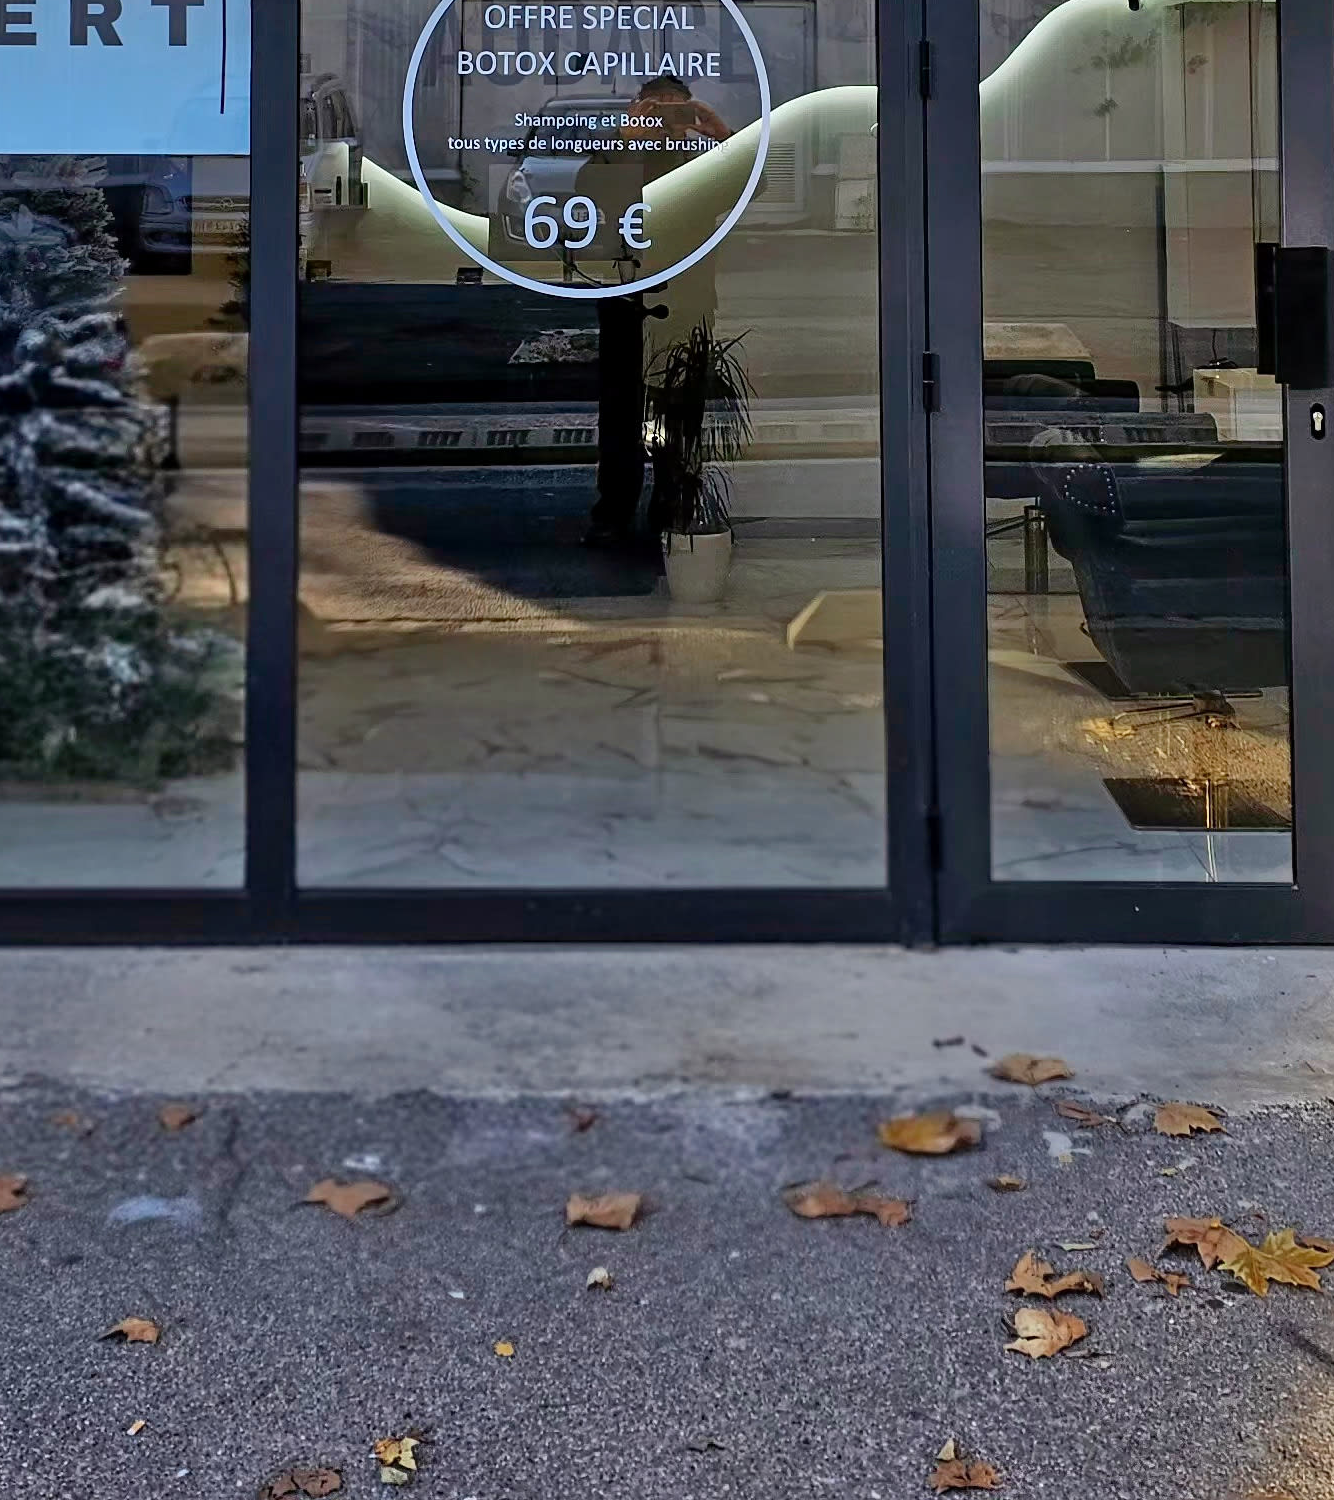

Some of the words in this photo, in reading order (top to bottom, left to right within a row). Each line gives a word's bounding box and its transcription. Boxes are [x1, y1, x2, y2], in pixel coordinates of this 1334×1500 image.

[484, 4, 574, 29] OFFRE
[582, 5, 695, 30] SPECIAL
[457, 50, 556, 76] BOTOX
[564, 51, 721, 77] CAPILLAIRE
[514, 112, 598, 130] Shampoing
[601, 114, 617, 127] et
[620, 113, 663, 128] Botox
[447, 136, 481, 150] tous
[484, 136, 525, 153] types
[528, 135, 547, 150] de
[551, 135, 624, 153] longueurs
[627, 139, 662, 151] avec
[524, 195, 598, 249] 69
[618, 203, 652, 250] €
